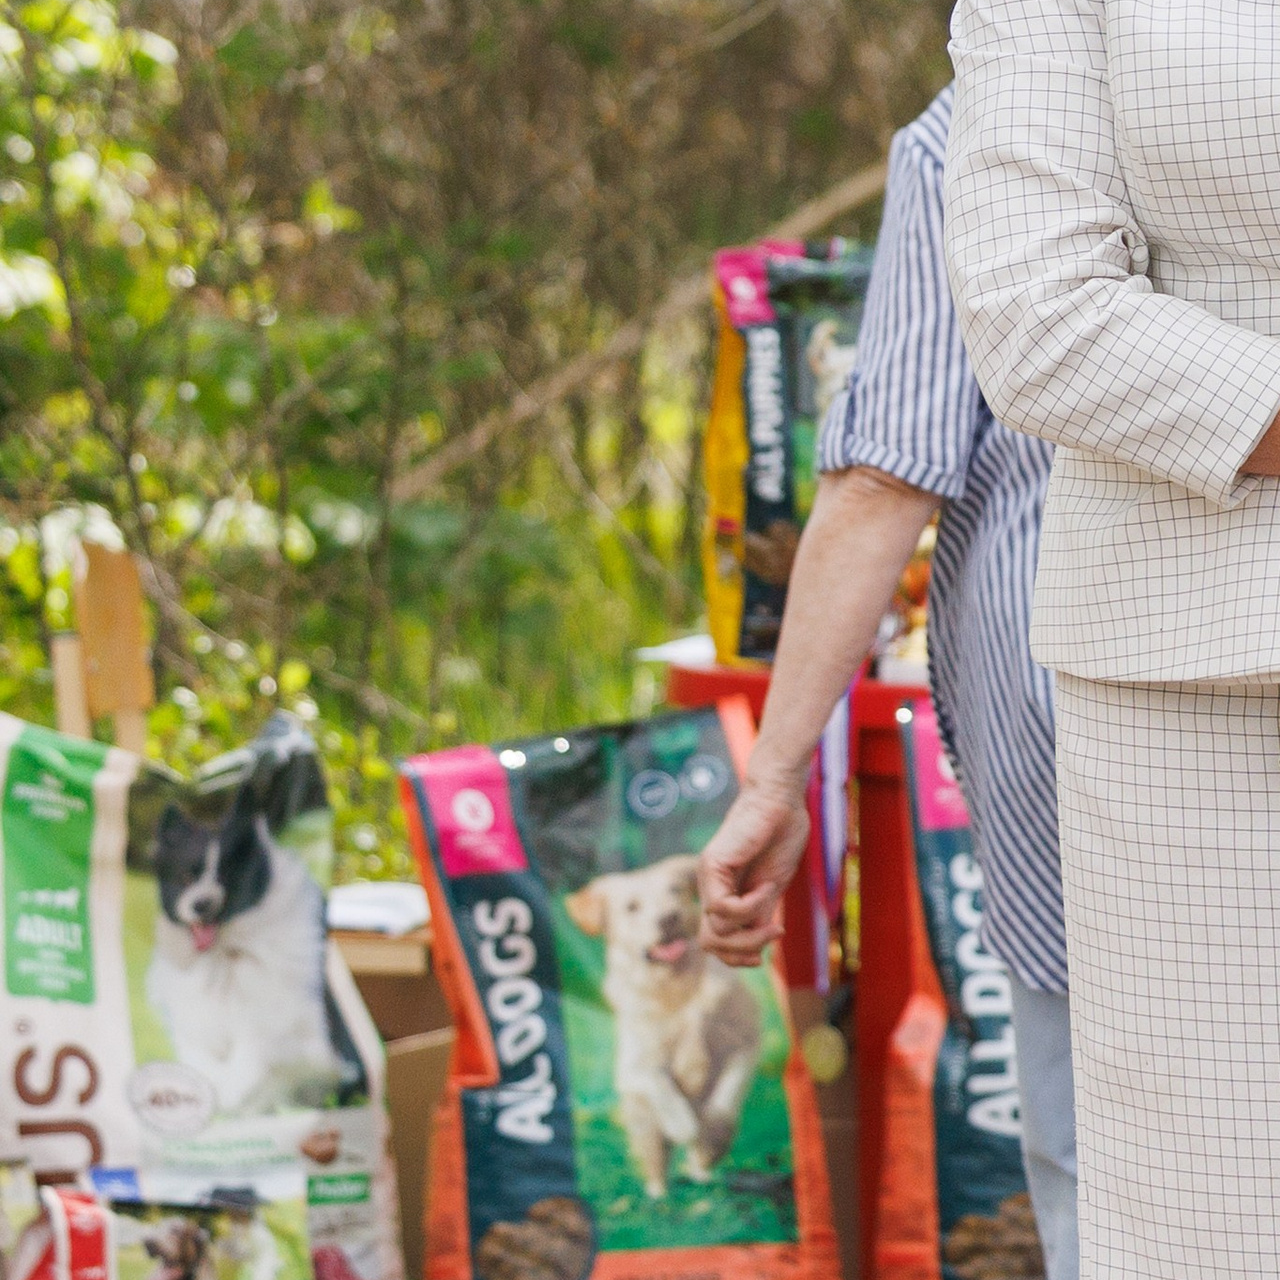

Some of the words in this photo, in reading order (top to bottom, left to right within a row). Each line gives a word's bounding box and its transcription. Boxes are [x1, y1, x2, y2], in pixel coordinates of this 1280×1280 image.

[473, 896, 547, 1068] DOGS
[494, 1052, 557, 1145] ALL
[965, 1024, 1025, 1138] ALL
